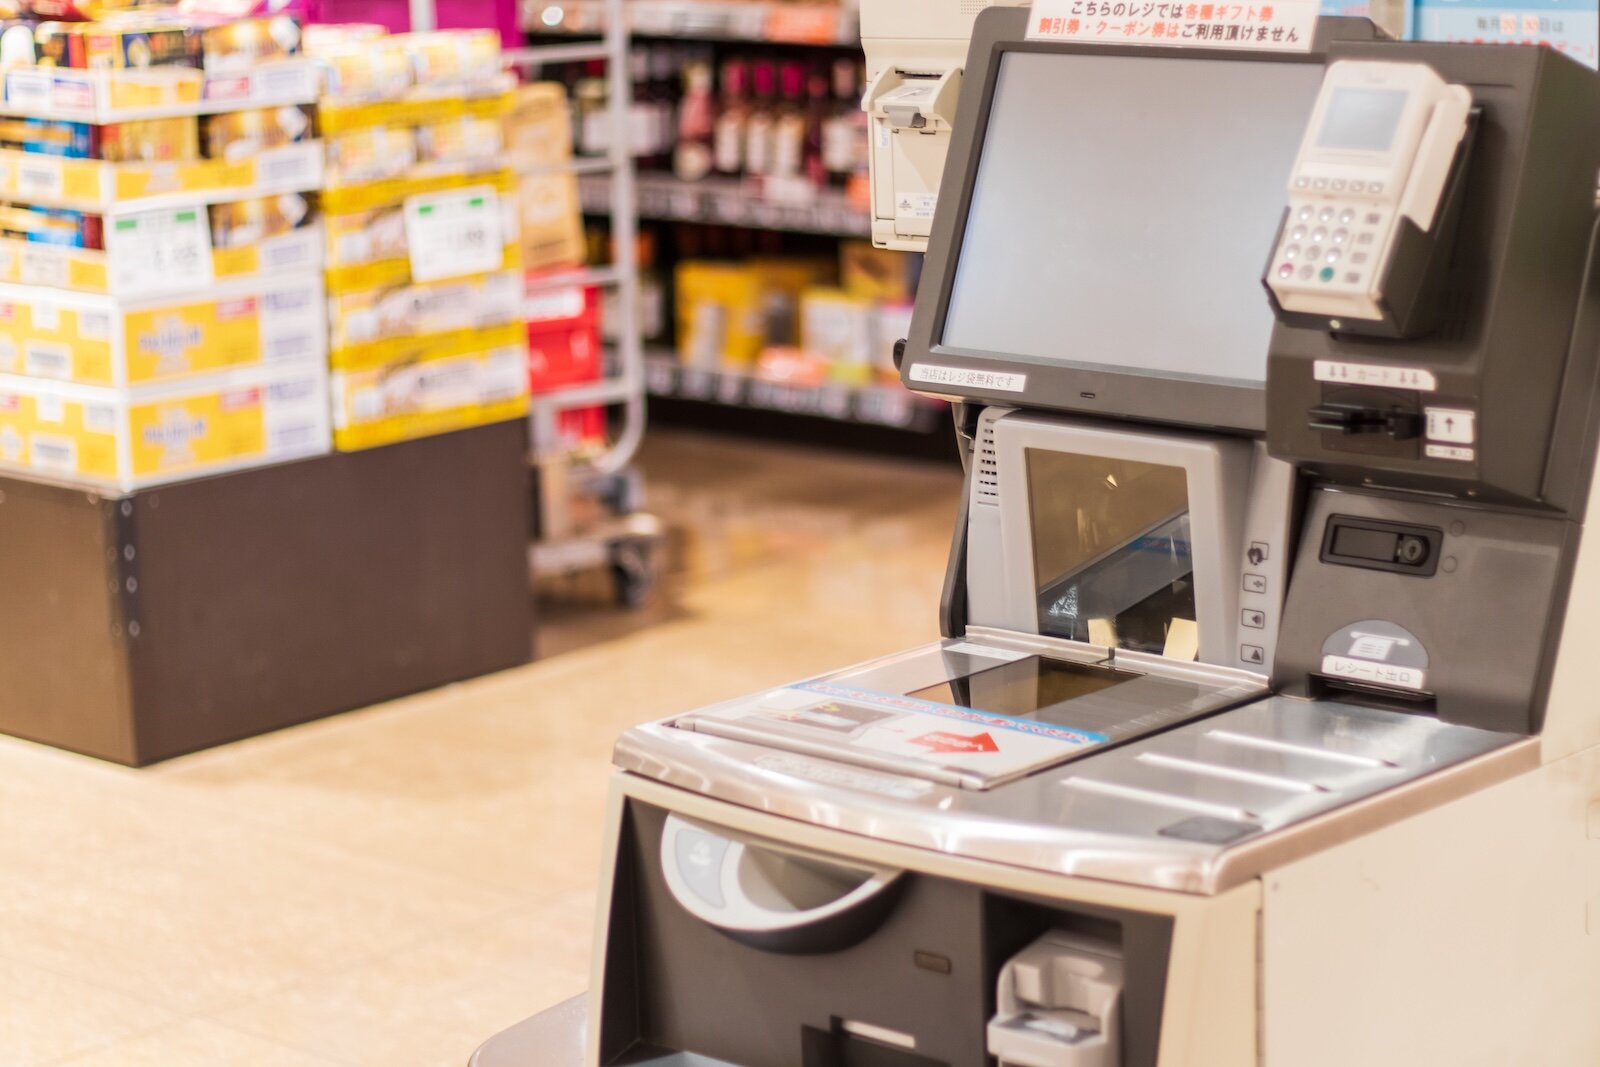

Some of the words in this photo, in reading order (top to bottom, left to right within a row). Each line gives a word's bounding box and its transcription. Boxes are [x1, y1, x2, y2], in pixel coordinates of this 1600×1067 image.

[1071, 1, 1275, 22] こちらのレジでは各種ギフト券
[1038, 17, 1300, 43] 割引券・クーポン券はご利用頂けません
[920, 367, 1015, 387] 当店はレジ袋無料です
[1334, 661, 1411, 683] レシート出口
